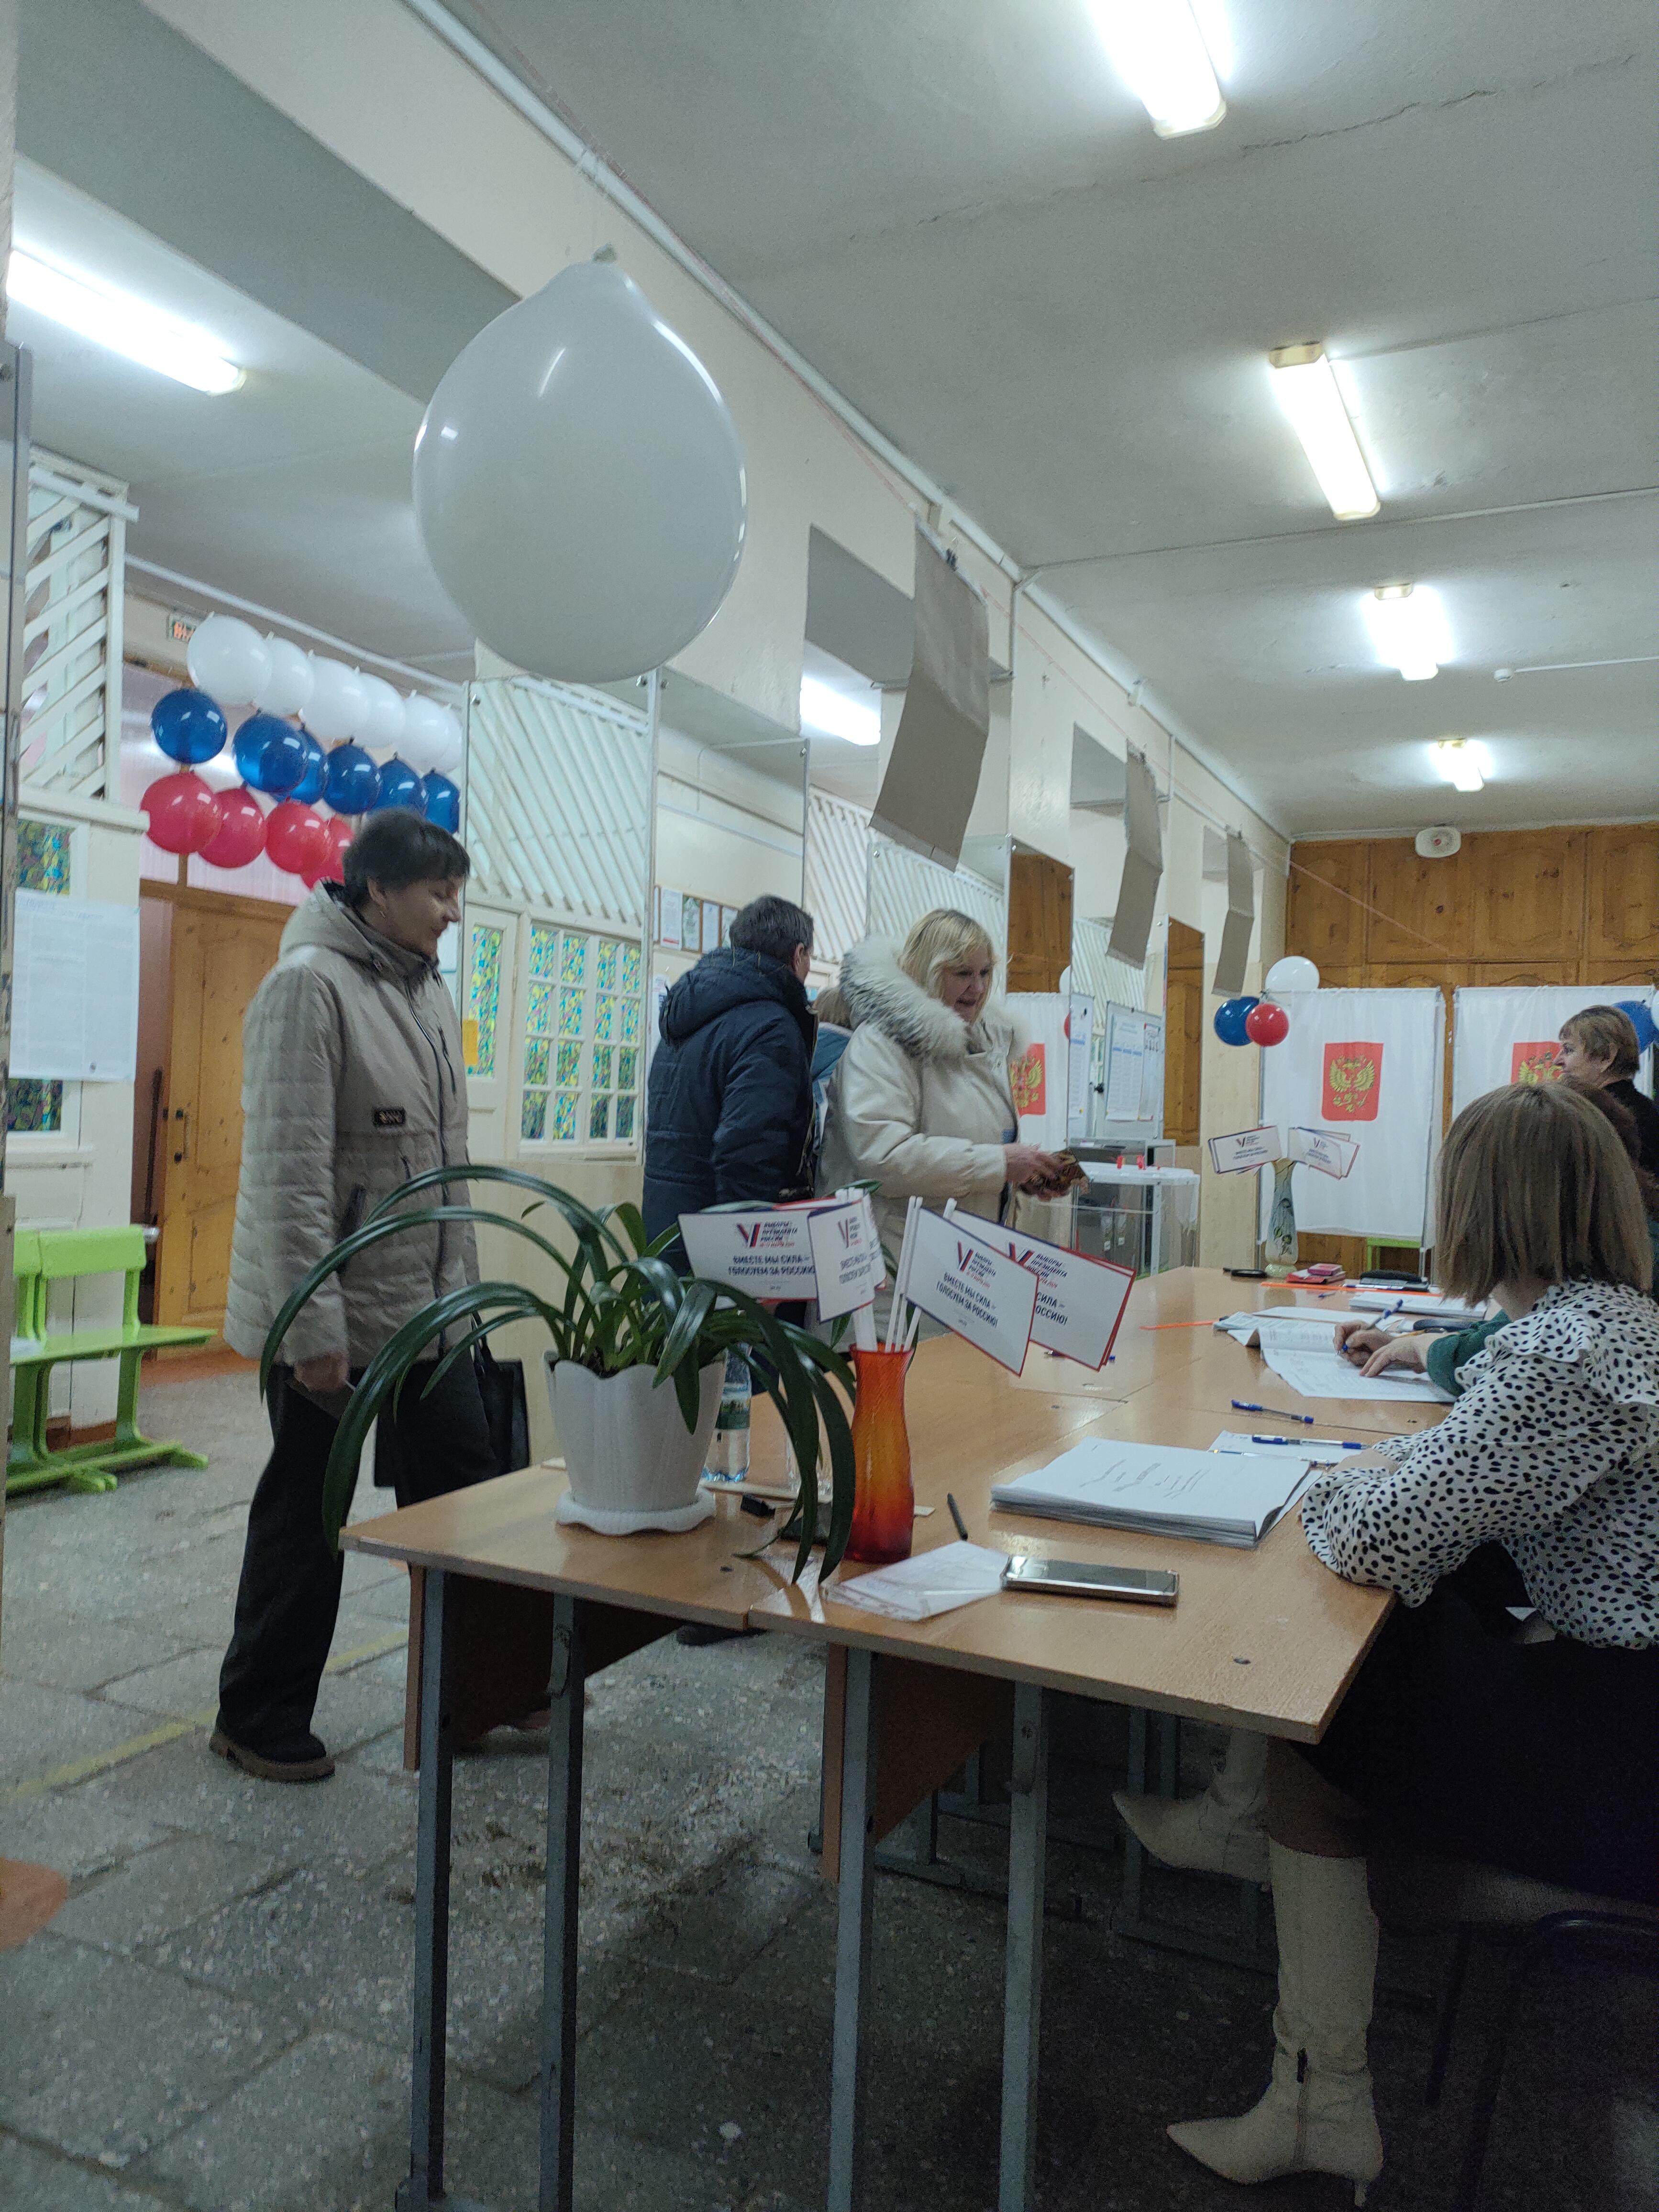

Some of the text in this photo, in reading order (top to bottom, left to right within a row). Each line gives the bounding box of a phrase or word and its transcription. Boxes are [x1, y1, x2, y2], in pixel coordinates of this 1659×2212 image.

[780, 1255, 803, 1264] СИЛА
[936, 1281, 964, 1306] ГОЛОСУЕМ
[944, 1272, 964, 1293] ВМЕСТЕ
[964, 1285, 975, 1299] МЫ
[975, 1292, 990, 1309] СИЛА
[1037, 1292, 1057, 1308] СИЛА
[1036, 1305, 1068, 1326] ОССИЮ!
